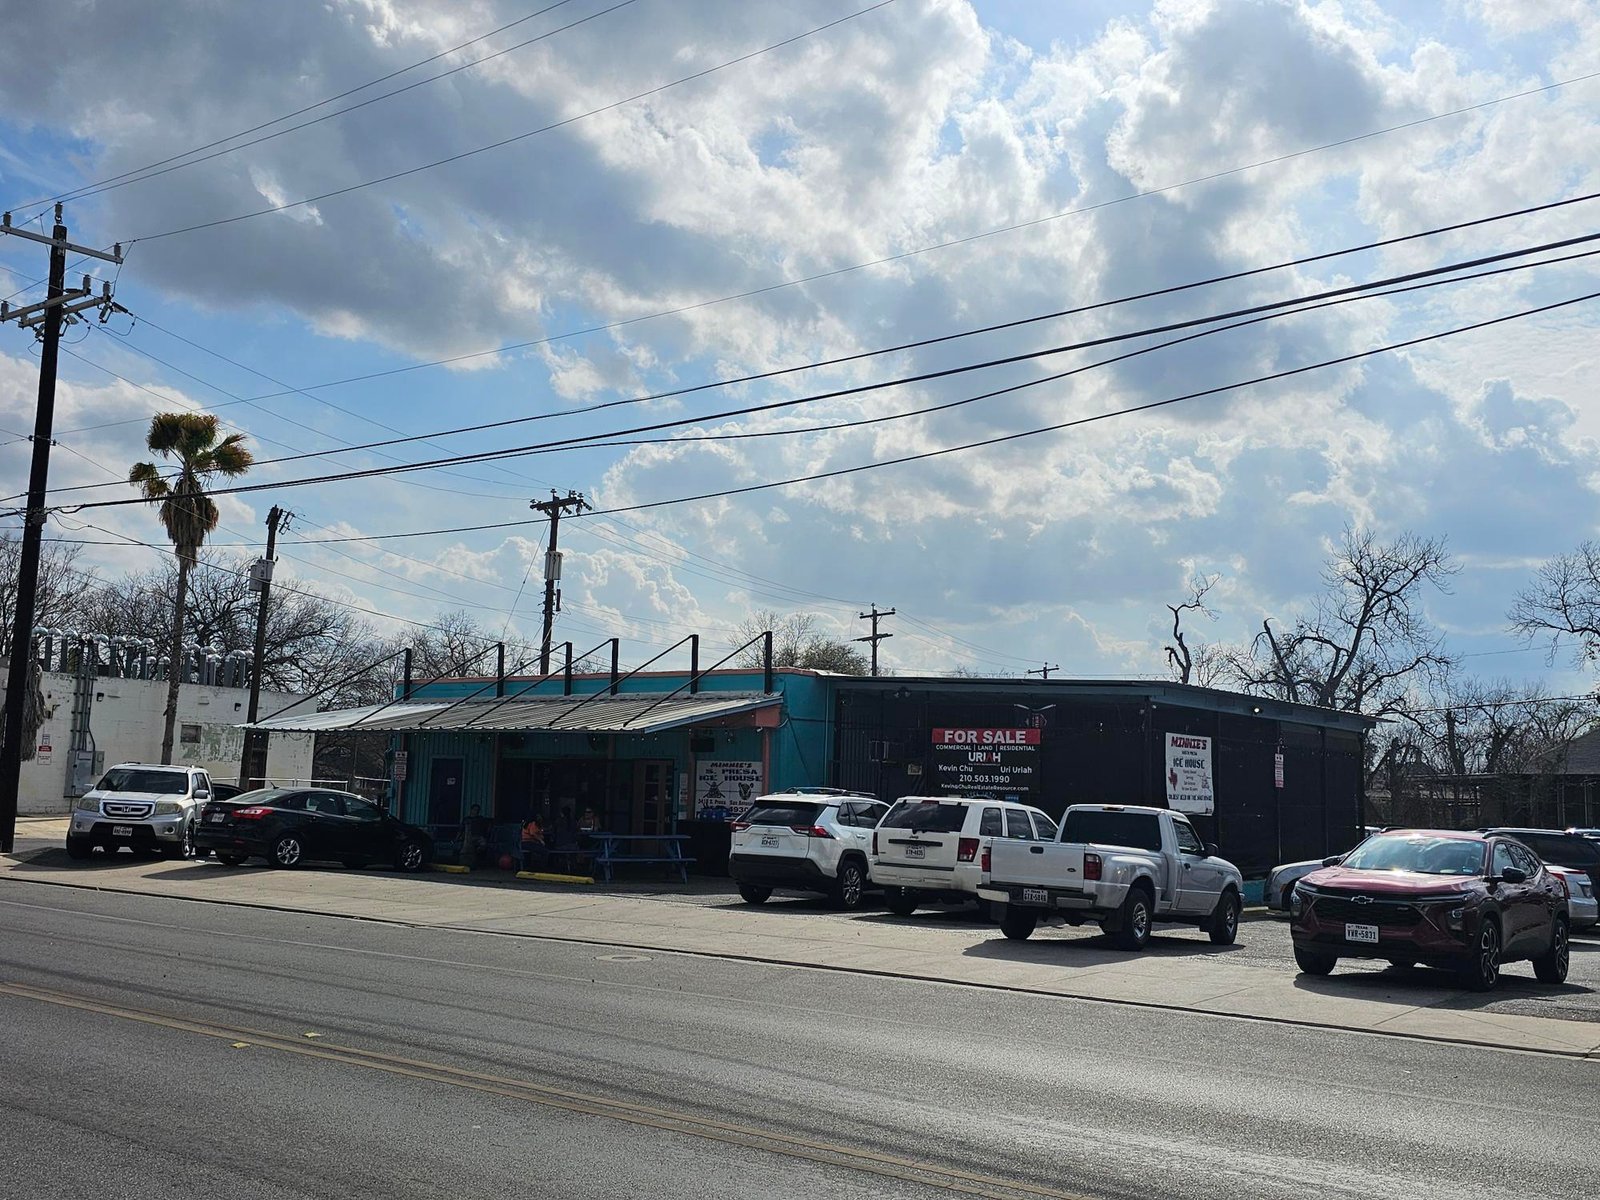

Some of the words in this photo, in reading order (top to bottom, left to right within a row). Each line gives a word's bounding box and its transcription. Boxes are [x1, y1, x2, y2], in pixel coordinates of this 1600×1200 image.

[944, 730, 978, 743] FOR
[982, 730, 1026, 744] SALE
[1171, 736, 1207, 750] MINNIE'S
[968, 752, 1001, 762] URIAH
[938, 764, 958, 772] Kevin
[959, 764, 973, 772] Chu
[1185, 758, 1205, 769] HOUSE
[1012, 766, 1032, 774] Uriah
[959, 774, 1010, 783] 210.503.1990
